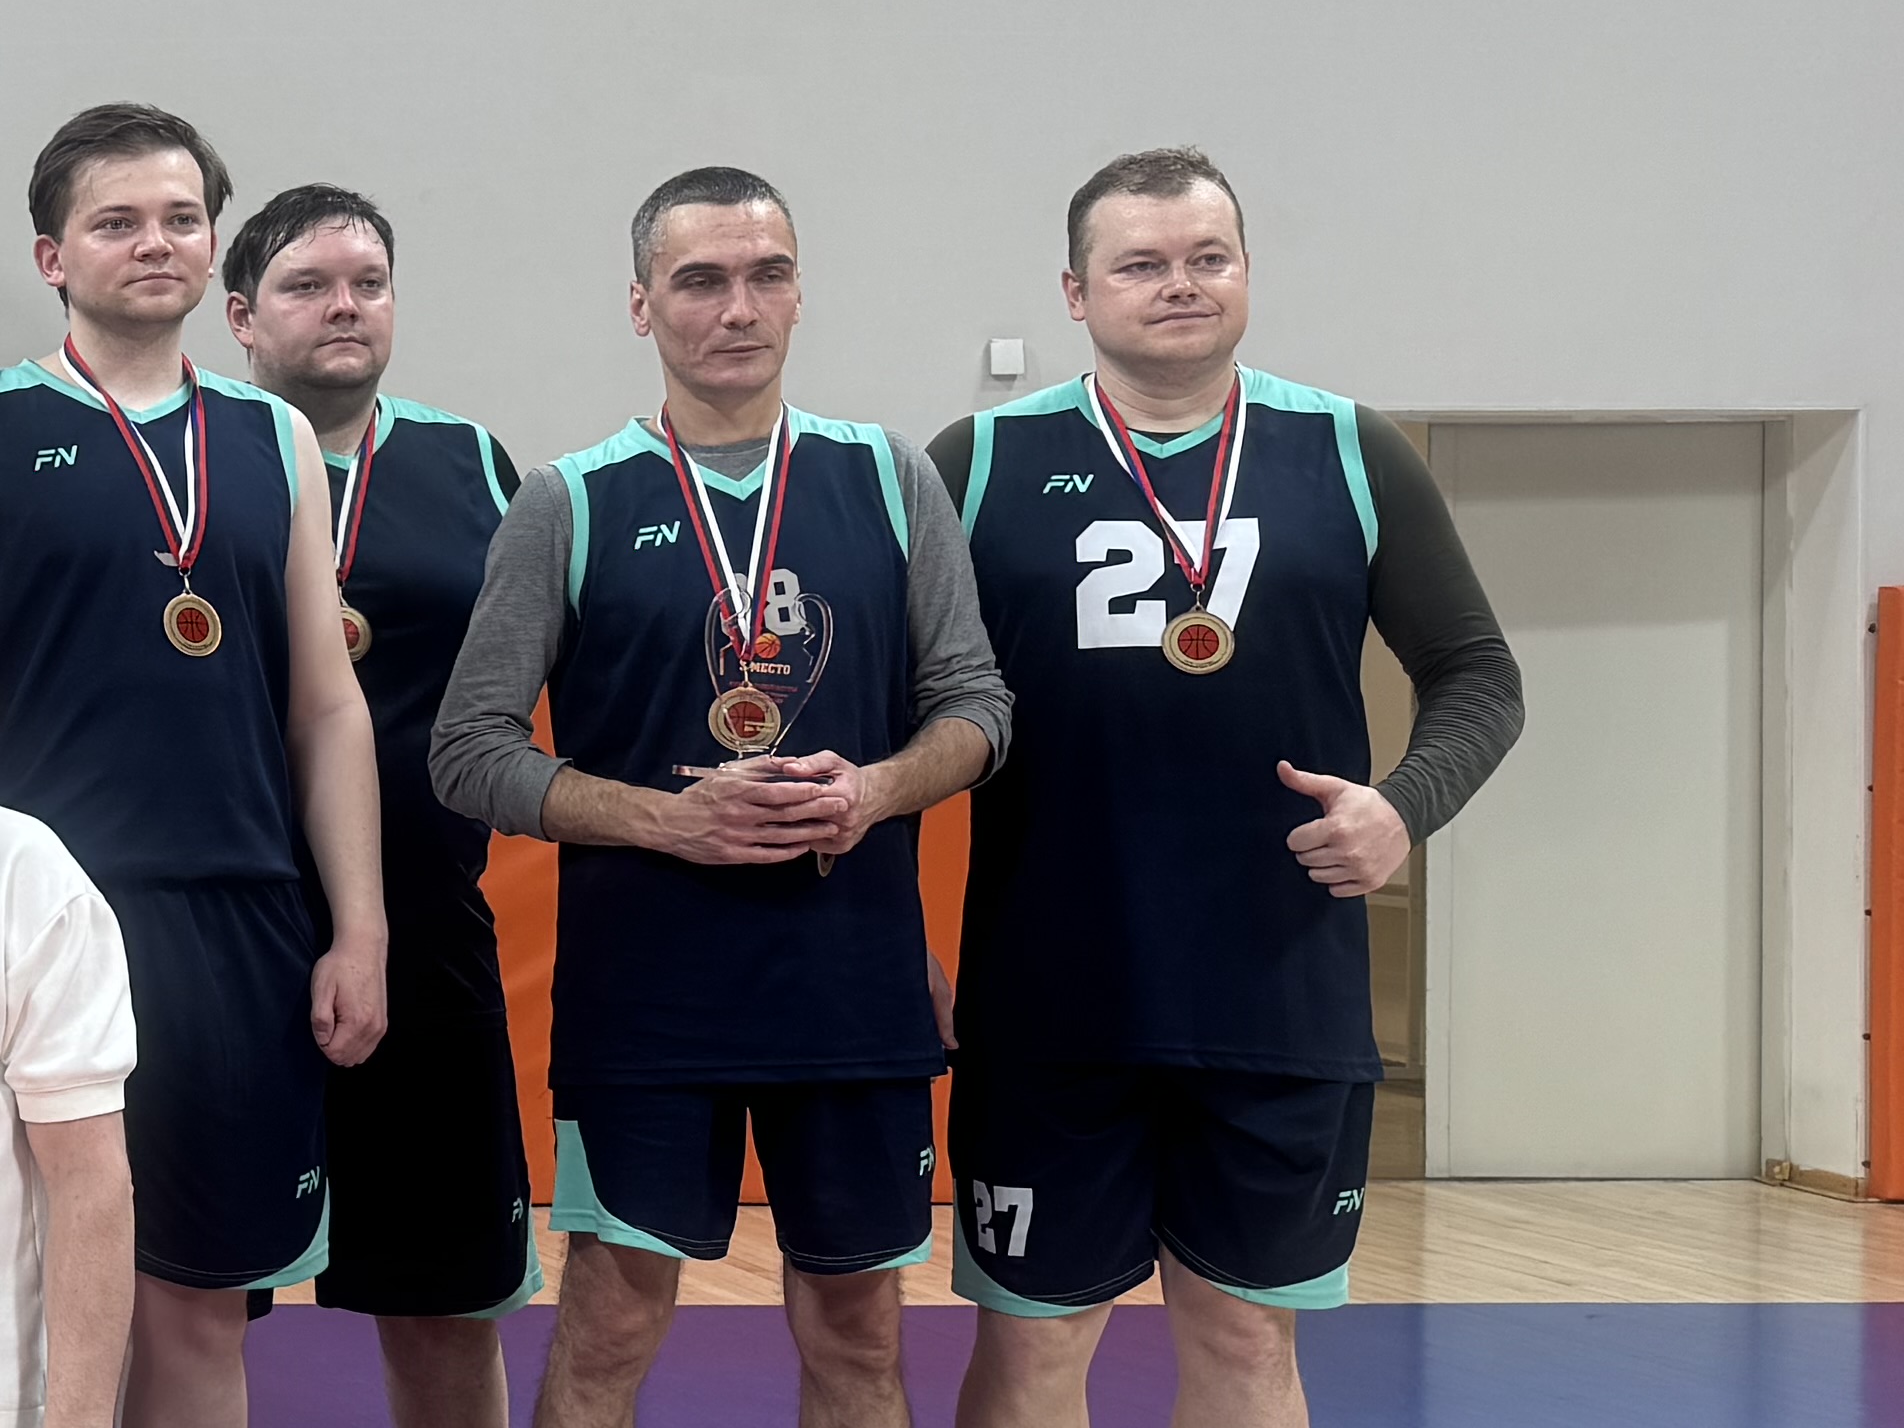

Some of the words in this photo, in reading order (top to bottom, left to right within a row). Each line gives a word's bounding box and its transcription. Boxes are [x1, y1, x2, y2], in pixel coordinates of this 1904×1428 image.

[34, 444, 79, 472] FN
[1042, 473, 1095, 494] FN
[633, 520, 681, 550] FN
[1075, 517, 1261, 650] 27
[750, 661, 791, 676] МЕСТО
[296, 1165, 320, 1199] FN
[1333, 1187, 1366, 1217] FN
[972, 1179, 1034, 1258] 27
